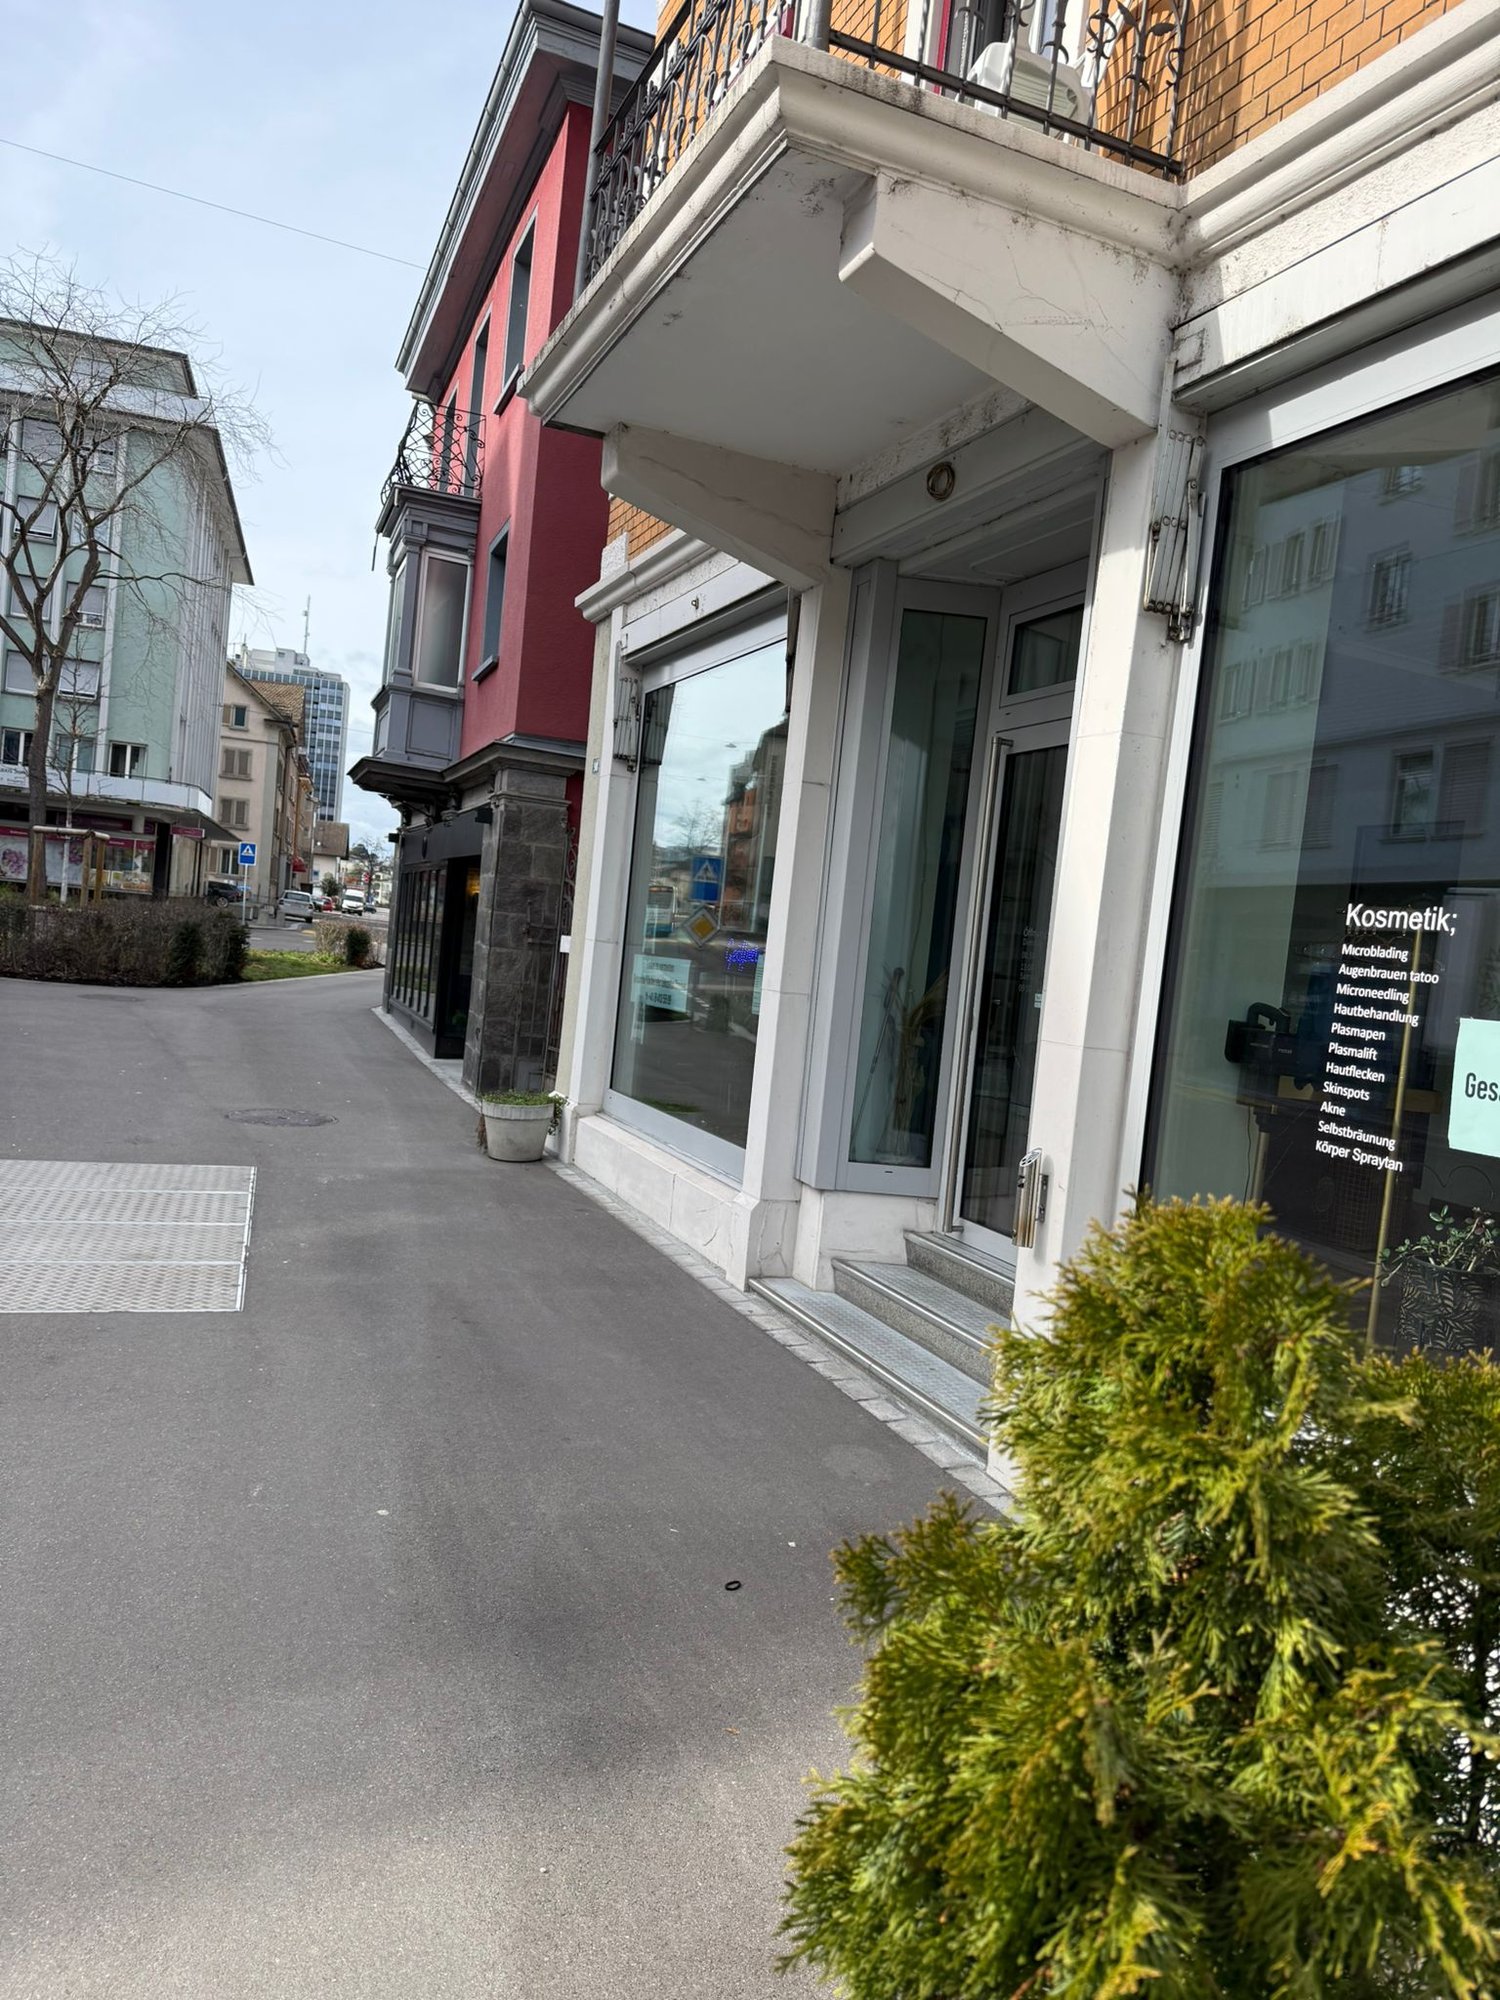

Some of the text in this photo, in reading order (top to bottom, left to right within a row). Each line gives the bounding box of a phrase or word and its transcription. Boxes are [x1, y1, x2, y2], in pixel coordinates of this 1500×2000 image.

[1345, 903, 1457, 936] Kosmetik;
[1341, 943, 1409, 962] Microblading
[1338, 963, 1440, 984] Augenbrauen tatoo
[1336, 983, 1410, 1005] Microneedling
[1333, 1002, 1419, 1028] Hautbehandlung
[1330, 1022, 1386, 1041] Plasmapen
[1328, 1042, 1378, 1061] Plasmalift
[1325, 1061, 1385, 1083] Hautflecken
[1322, 1081, 1370, 1101] Skinspots
[1464, 1072, 1500, 1102] Ges
[1320, 1101, 1346, 1116] Akne
[1317, 1120, 1396, 1152] Selbstbräunung
[1315, 1139, 1403, 1172] Körper Spraytan
